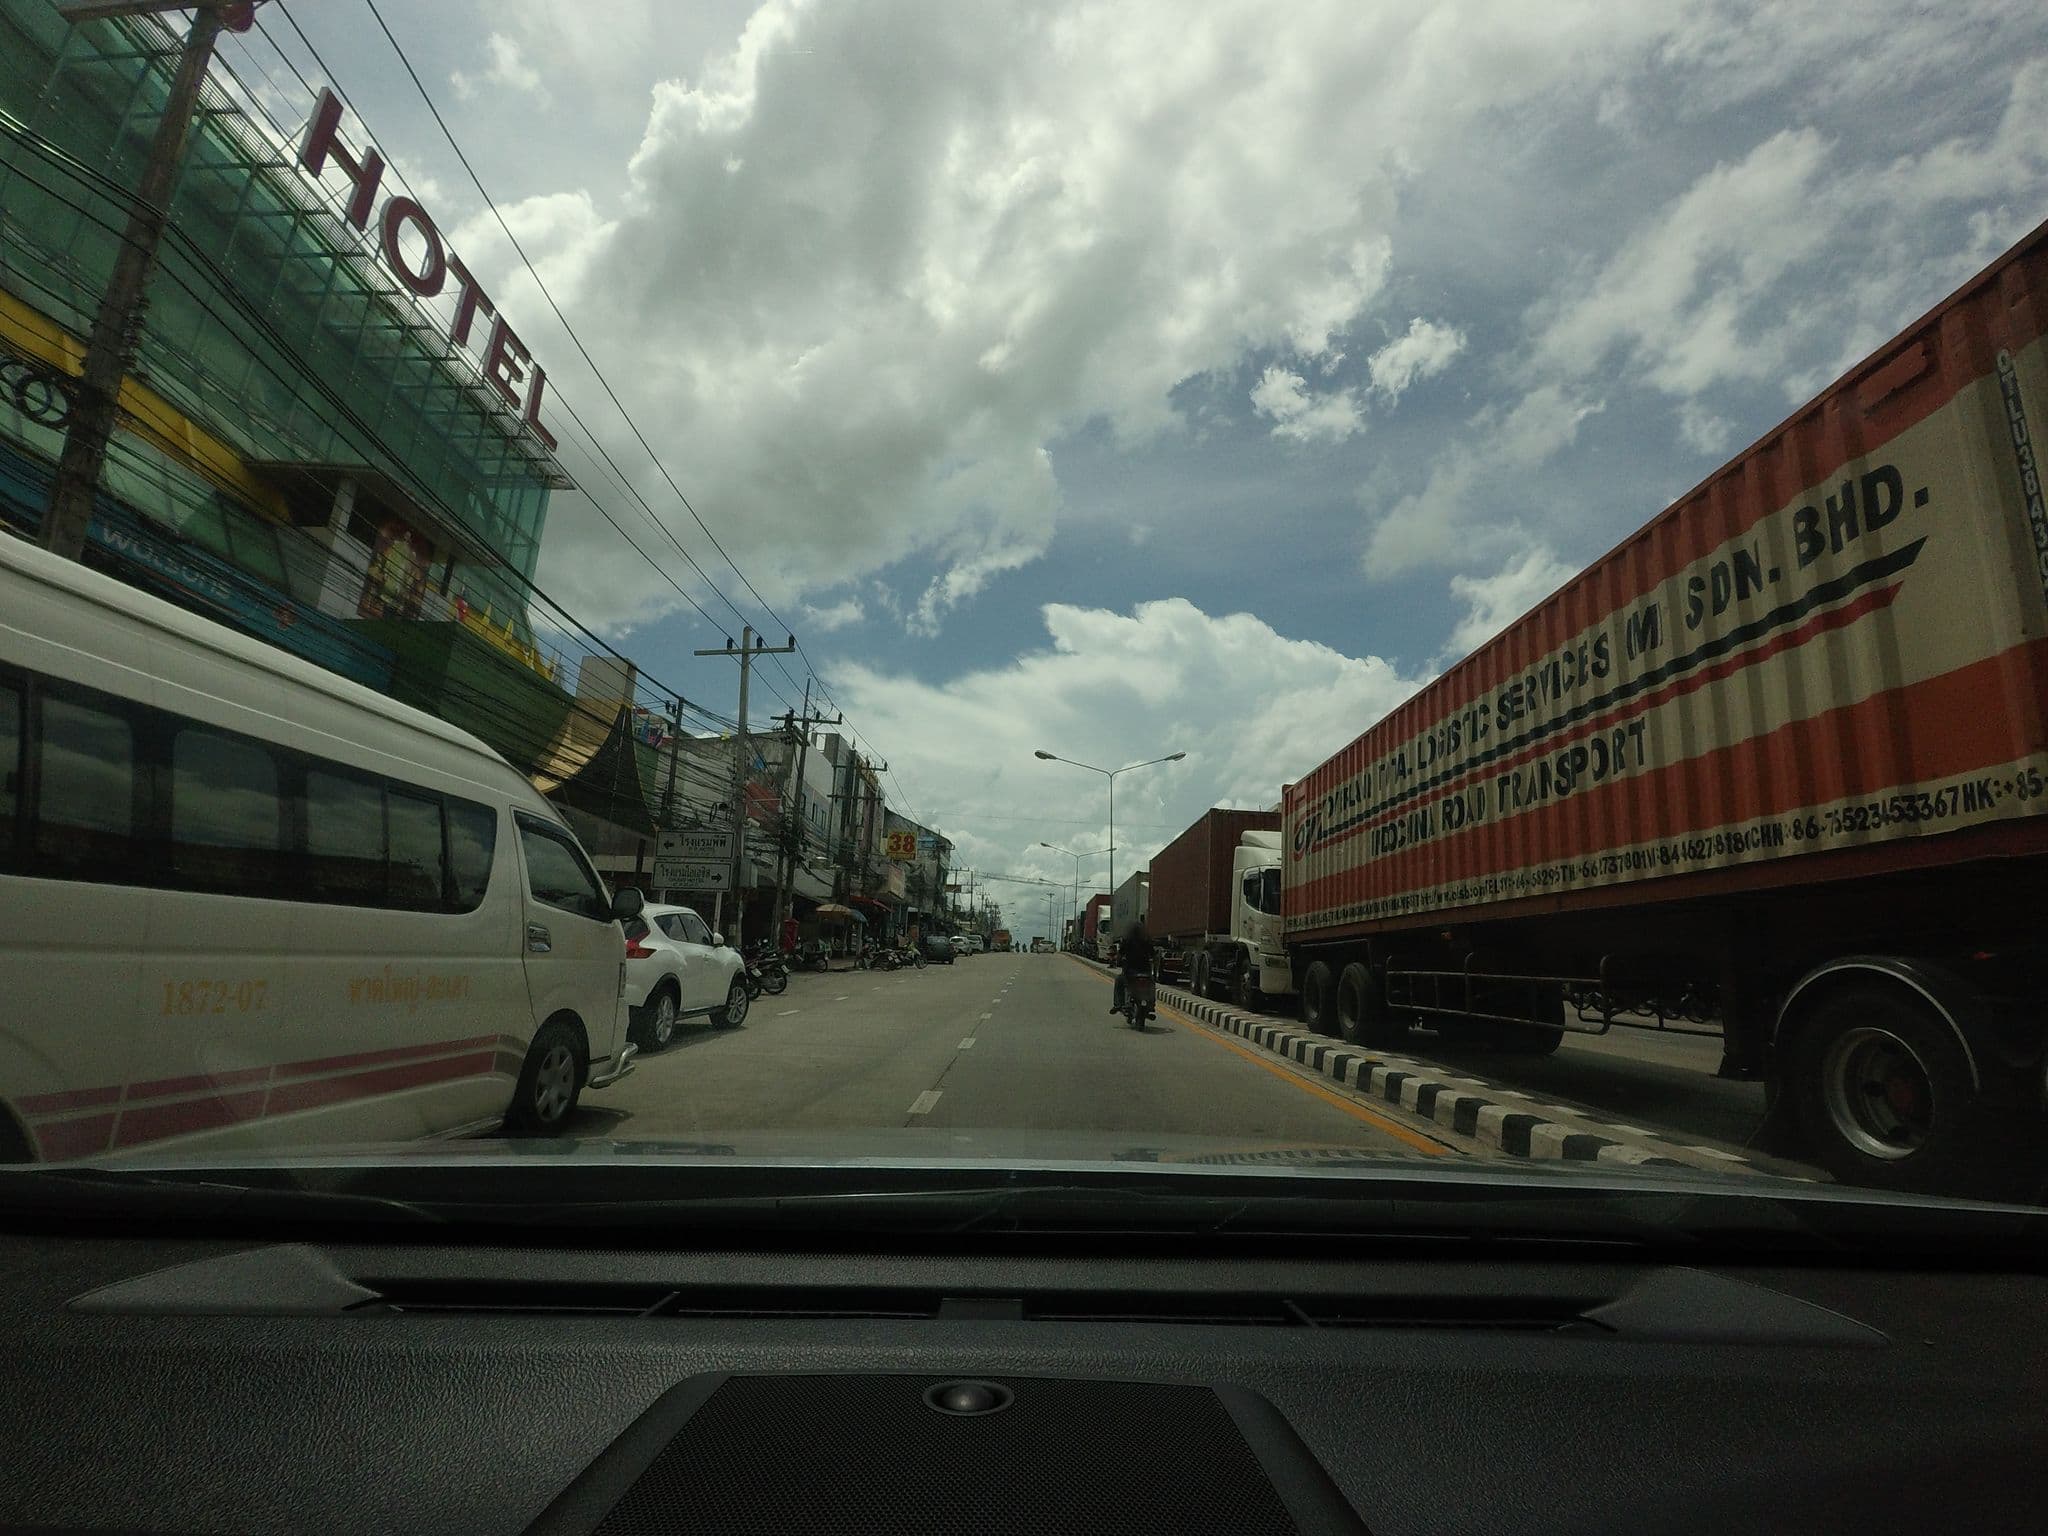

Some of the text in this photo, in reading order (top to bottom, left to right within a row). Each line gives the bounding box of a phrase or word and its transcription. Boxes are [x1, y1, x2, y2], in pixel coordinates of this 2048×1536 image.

[299, 85, 558, 452] HOTEL
[1416, 703, 1490, 769] LOGISTIC
[1496, 632, 1610, 730] SERVICES
[1686, 537, 1780, 631] SDN.
[1793, 463, 1929, 568] BHD.
[1442, 786, 1487, 832] ROAD
[1497, 717, 1645, 813] TRANSPORT
[889, 831, 915, 852] 38
[163, 979, 268, 1017] 1872-07
